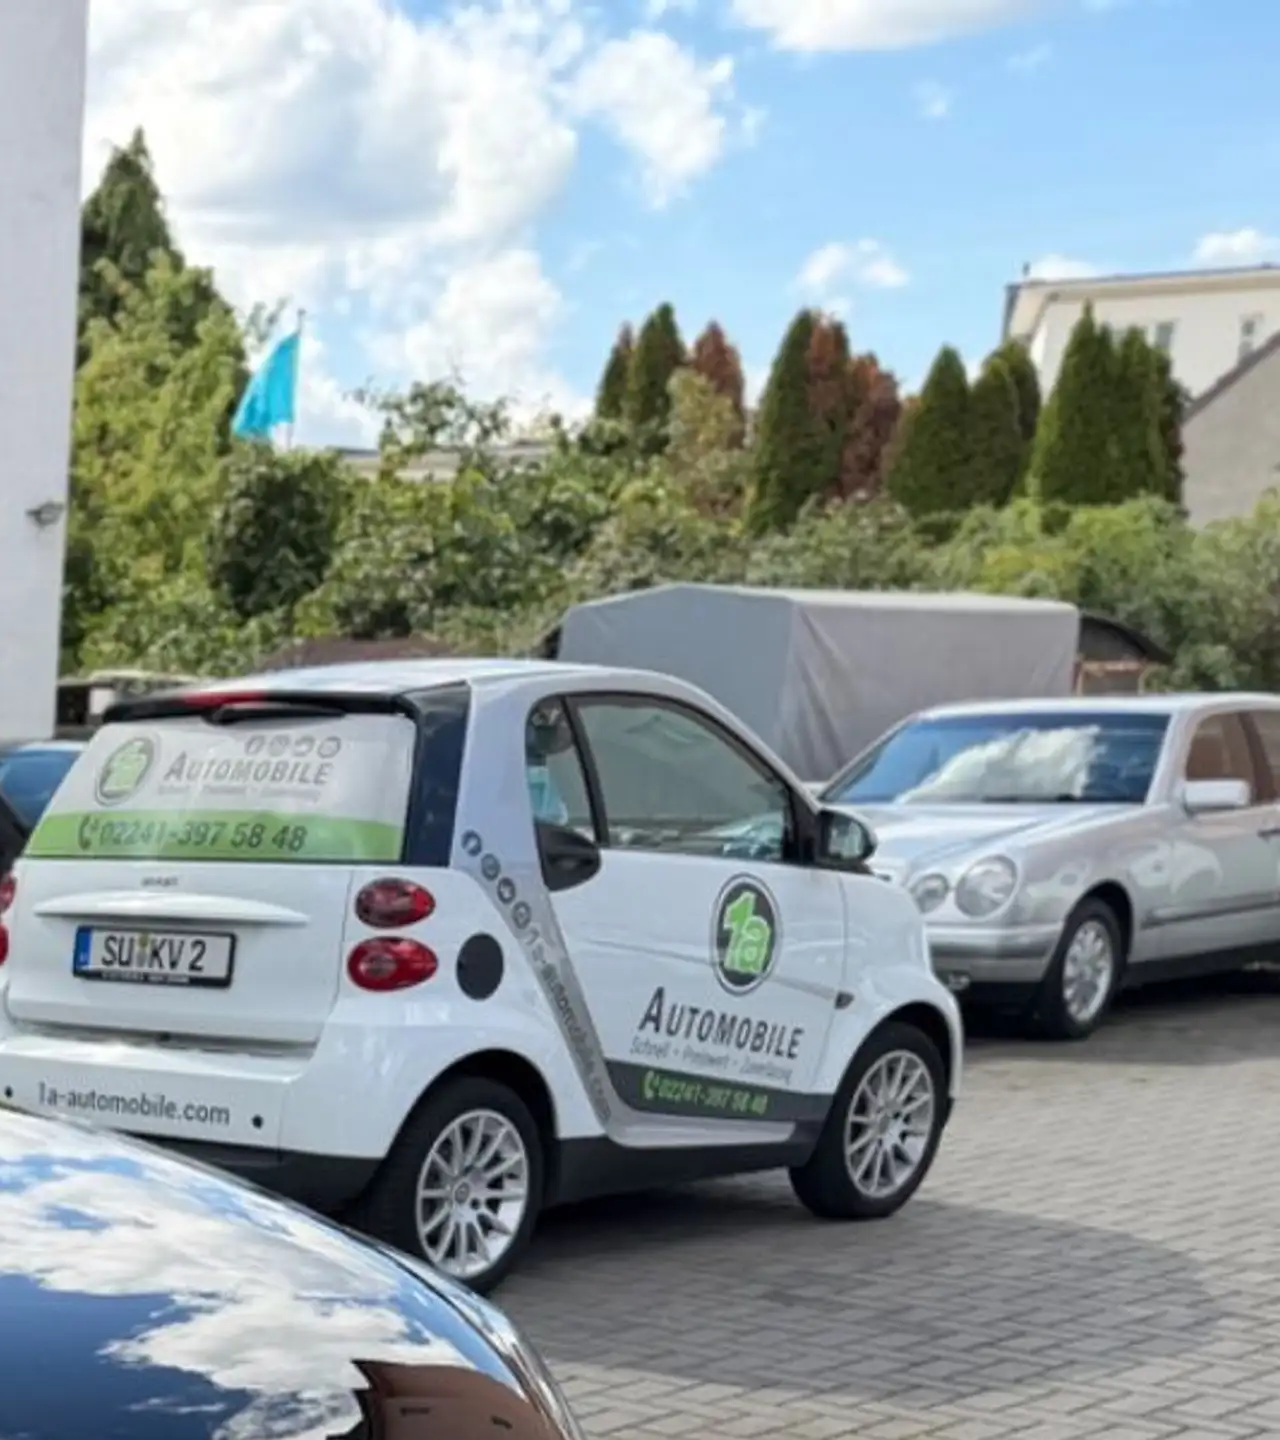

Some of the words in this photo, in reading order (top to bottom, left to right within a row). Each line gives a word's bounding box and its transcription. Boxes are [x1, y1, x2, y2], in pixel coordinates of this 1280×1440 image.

[164, 751, 334, 787] AUTOMOBILE
[230, 822, 267, 849] 58
[272, 825, 308, 852] 48
[101, 935, 135, 967] SU
[148, 938, 185, 971] KV
[188, 940, 207, 972] 2
[638, 986, 805, 1059] AUTOMOBILE
[38, 1081, 230, 1126] 1a-automobile.com
